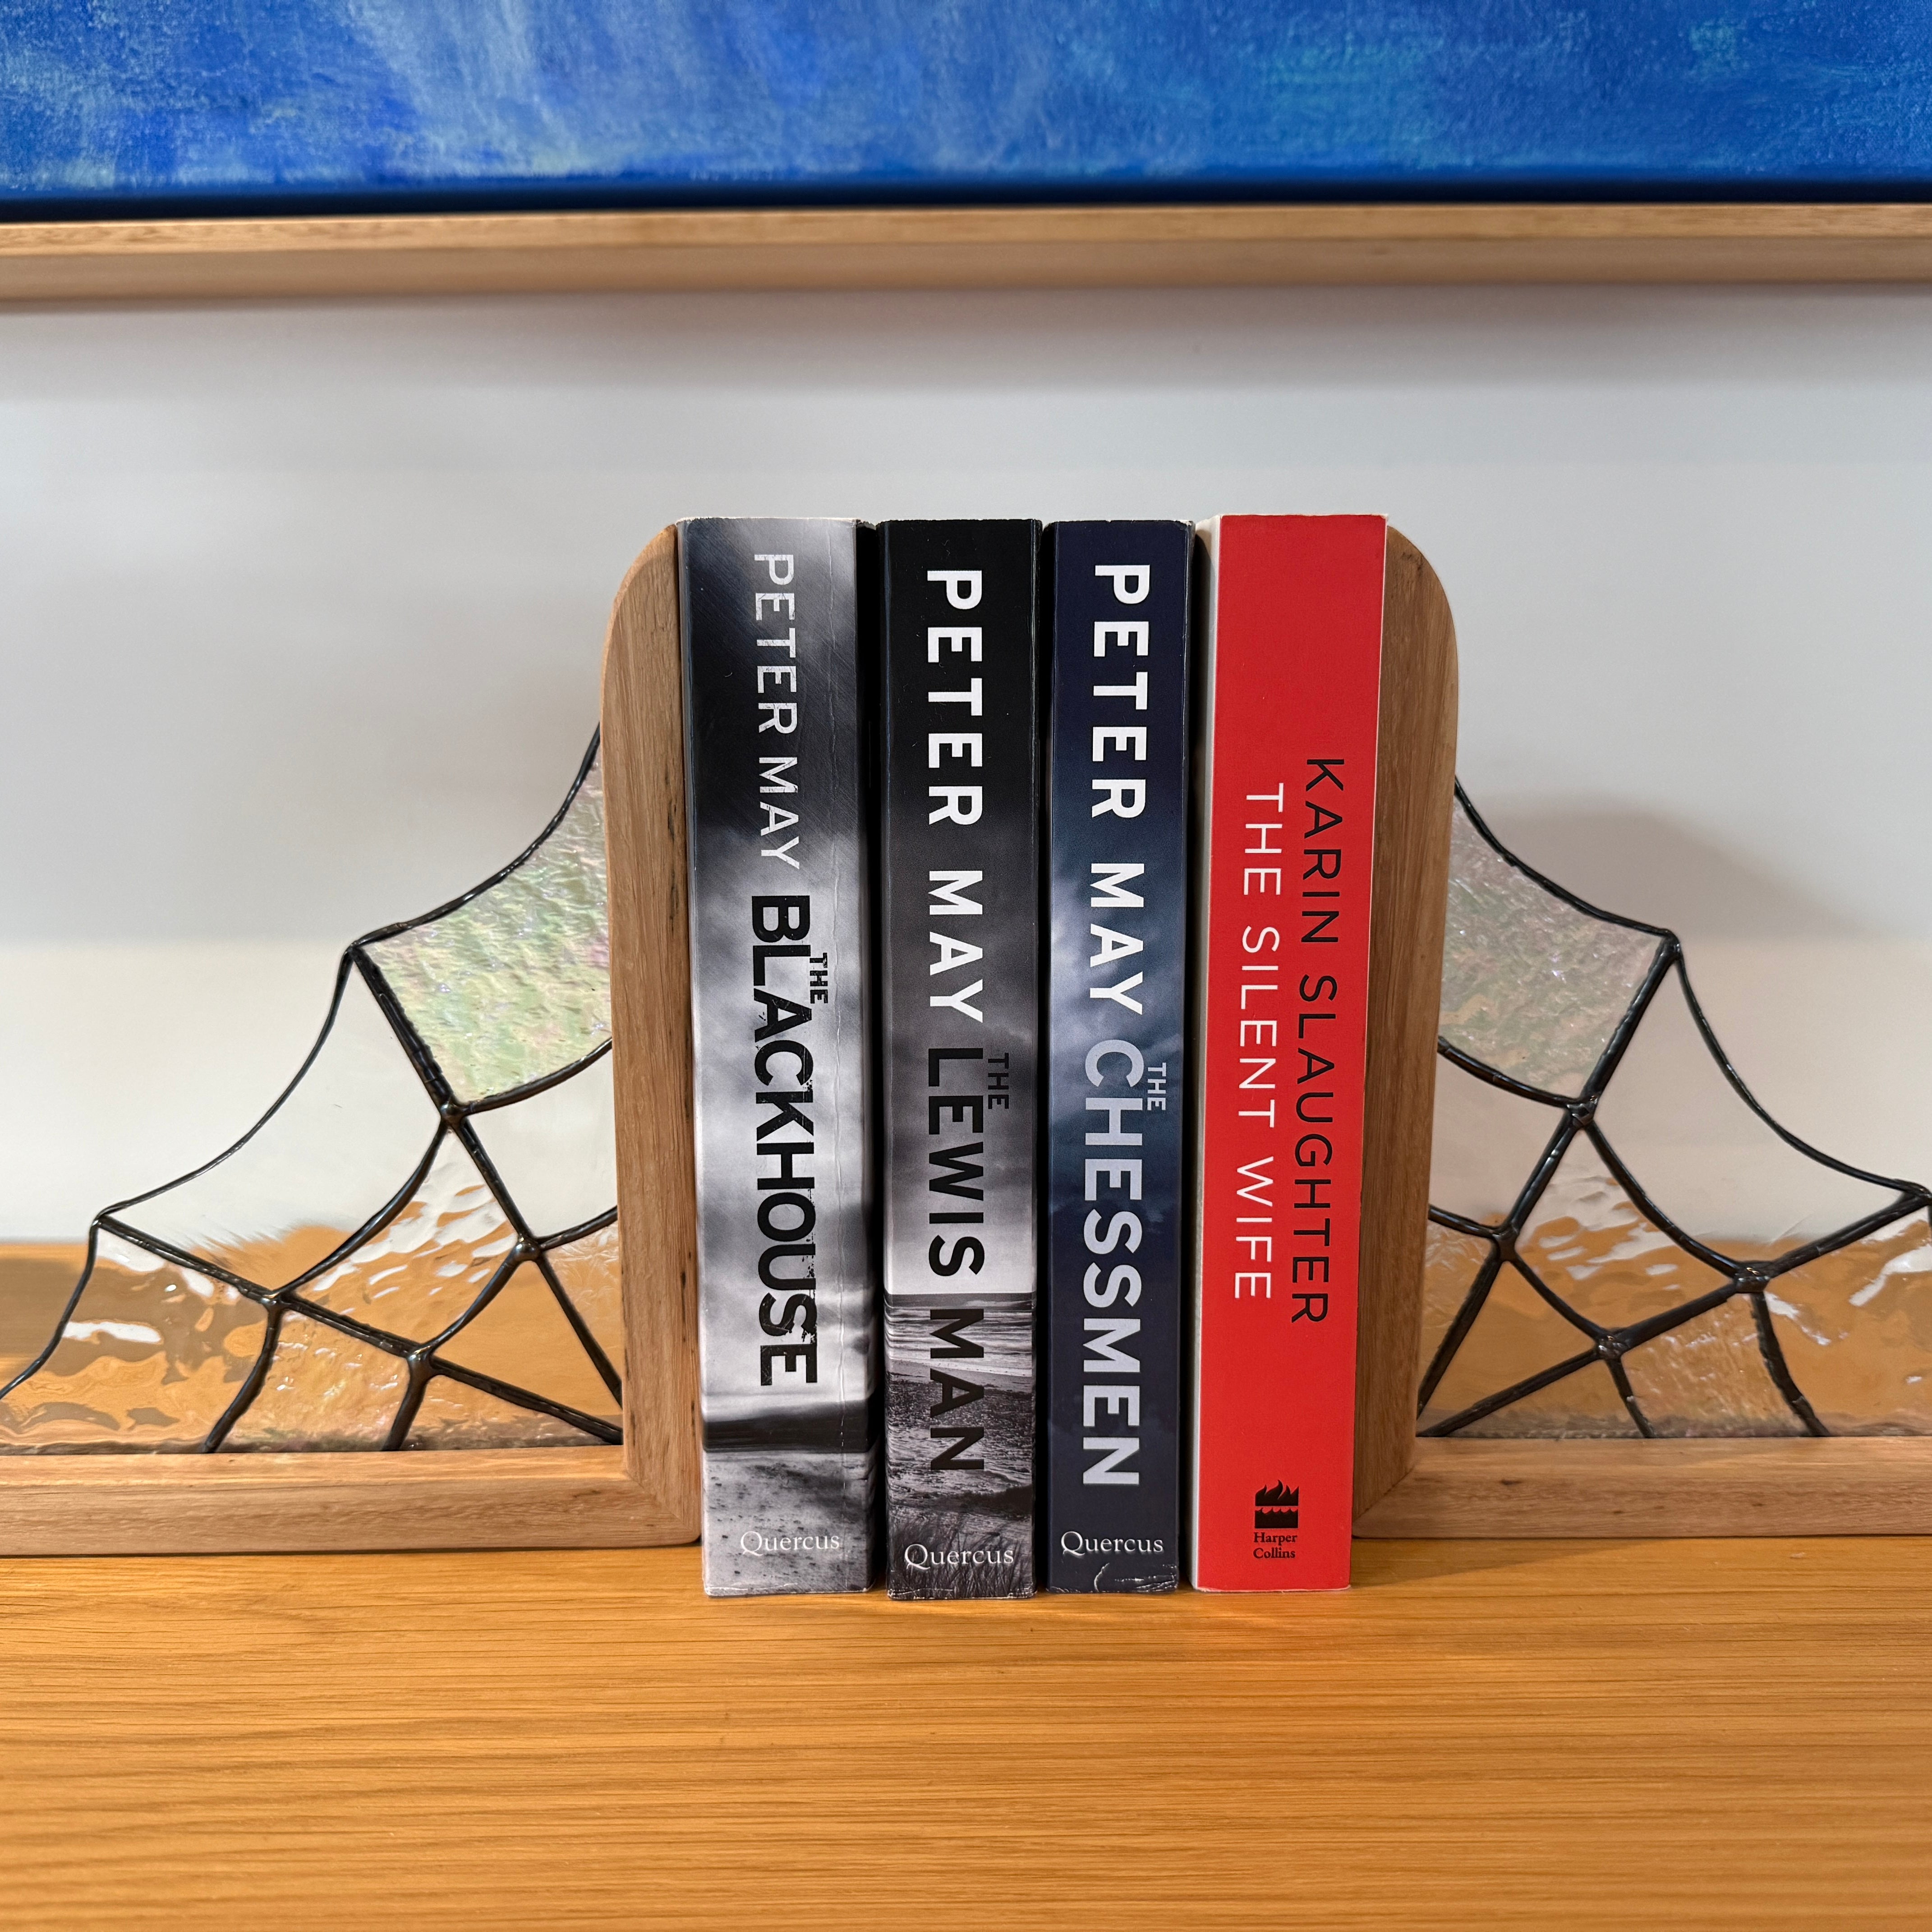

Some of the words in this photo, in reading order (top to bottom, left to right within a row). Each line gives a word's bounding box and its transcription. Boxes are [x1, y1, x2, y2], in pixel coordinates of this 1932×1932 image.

[754, 554, 798, 734] PETER
[927, 570, 983, 825] PETER
[1091, 564, 1150, 819] PETER
[759, 757, 800, 869] MAY
[1243, 782, 1284, 895] THE
[1301, 759, 1345, 943] KARIN
[809, 952, 828, 1004] THE
[928, 870, 984, 1023] MAY
[1090, 863, 1145, 1015] MAY
[988, 1053, 1009, 1109] THE
[1146, 1062, 1167, 1111] THE
[1238, 925, 1280, 1128] SILENT
[751, 895, 817, 1386] BLACKHOUSE
[928, 1048, 985, 1276] LEWIS
[1291, 974, 1338, 1323] SLAUGHTER
[1083, 1039, 1145, 1486] CHESSMEN
[1235, 1156, 1274, 1299] WIFE
[930, 1309, 985, 1470] MAN
[740, 1531, 840, 1556] Quercus
[904, 1544, 1014, 1570] Quercus
[1061, 1531, 1164, 1557] Quercus
[1253, 1532, 1298, 1546] Harper
[1253, 1547, 1296, 1559] Collins
